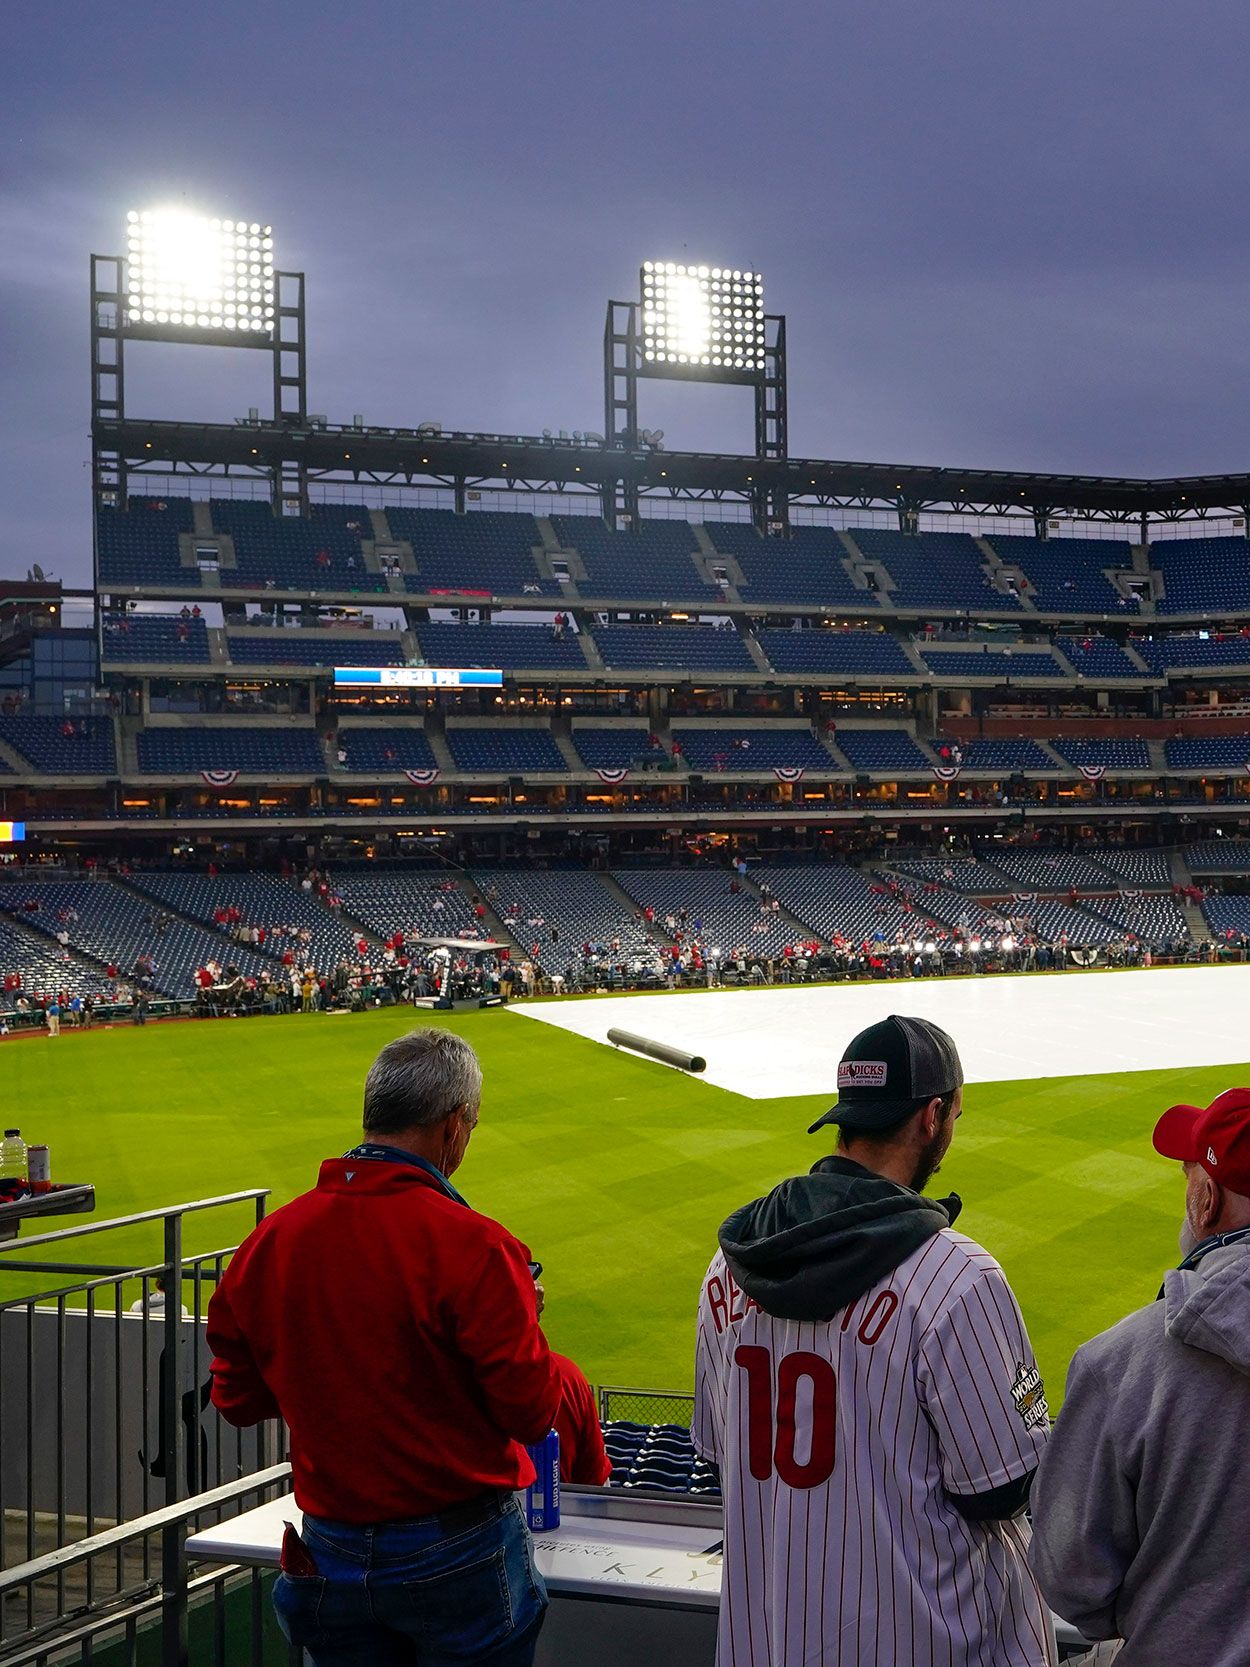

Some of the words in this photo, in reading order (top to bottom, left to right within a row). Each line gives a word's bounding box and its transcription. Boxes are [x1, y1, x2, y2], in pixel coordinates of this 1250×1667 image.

[855, 1065, 884, 1075] DICKS
[1011, 1369, 1040, 1402] WORLD
[734, 1345, 837, 1490] 10
[603, 1563, 715, 1582] KLY
